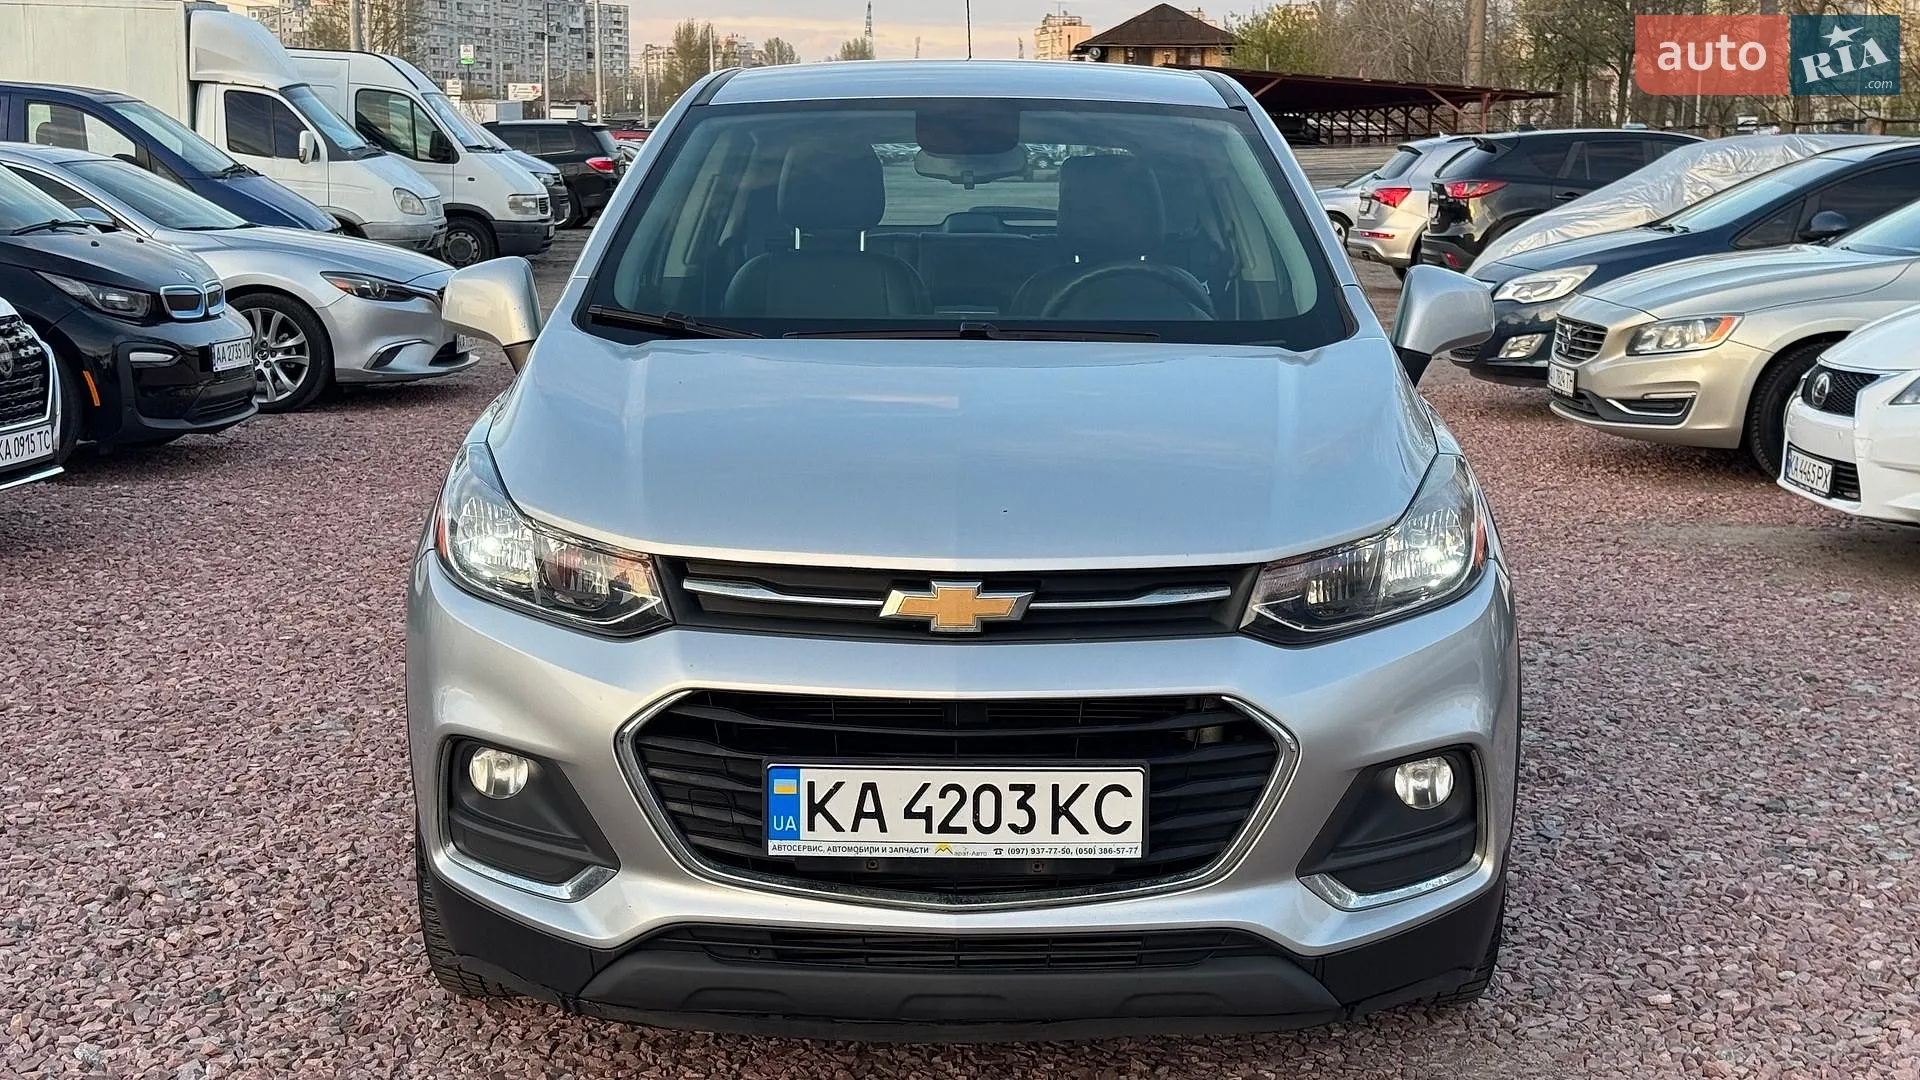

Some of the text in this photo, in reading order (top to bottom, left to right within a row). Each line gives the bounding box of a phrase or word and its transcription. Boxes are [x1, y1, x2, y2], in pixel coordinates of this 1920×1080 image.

[13, 432, 36, 458] 0915
[37, 429, 51, 452] TC
[1815, 465, 1831, 490] PX
[806, 780, 1134, 836] KA 4203 KC
[772, 815, 798, 832] UA
[881, 846, 887, 854] И
[888, 846, 929, 855] ЗАПЧАСТИ
[1007, 847, 1029, 856] (097)
